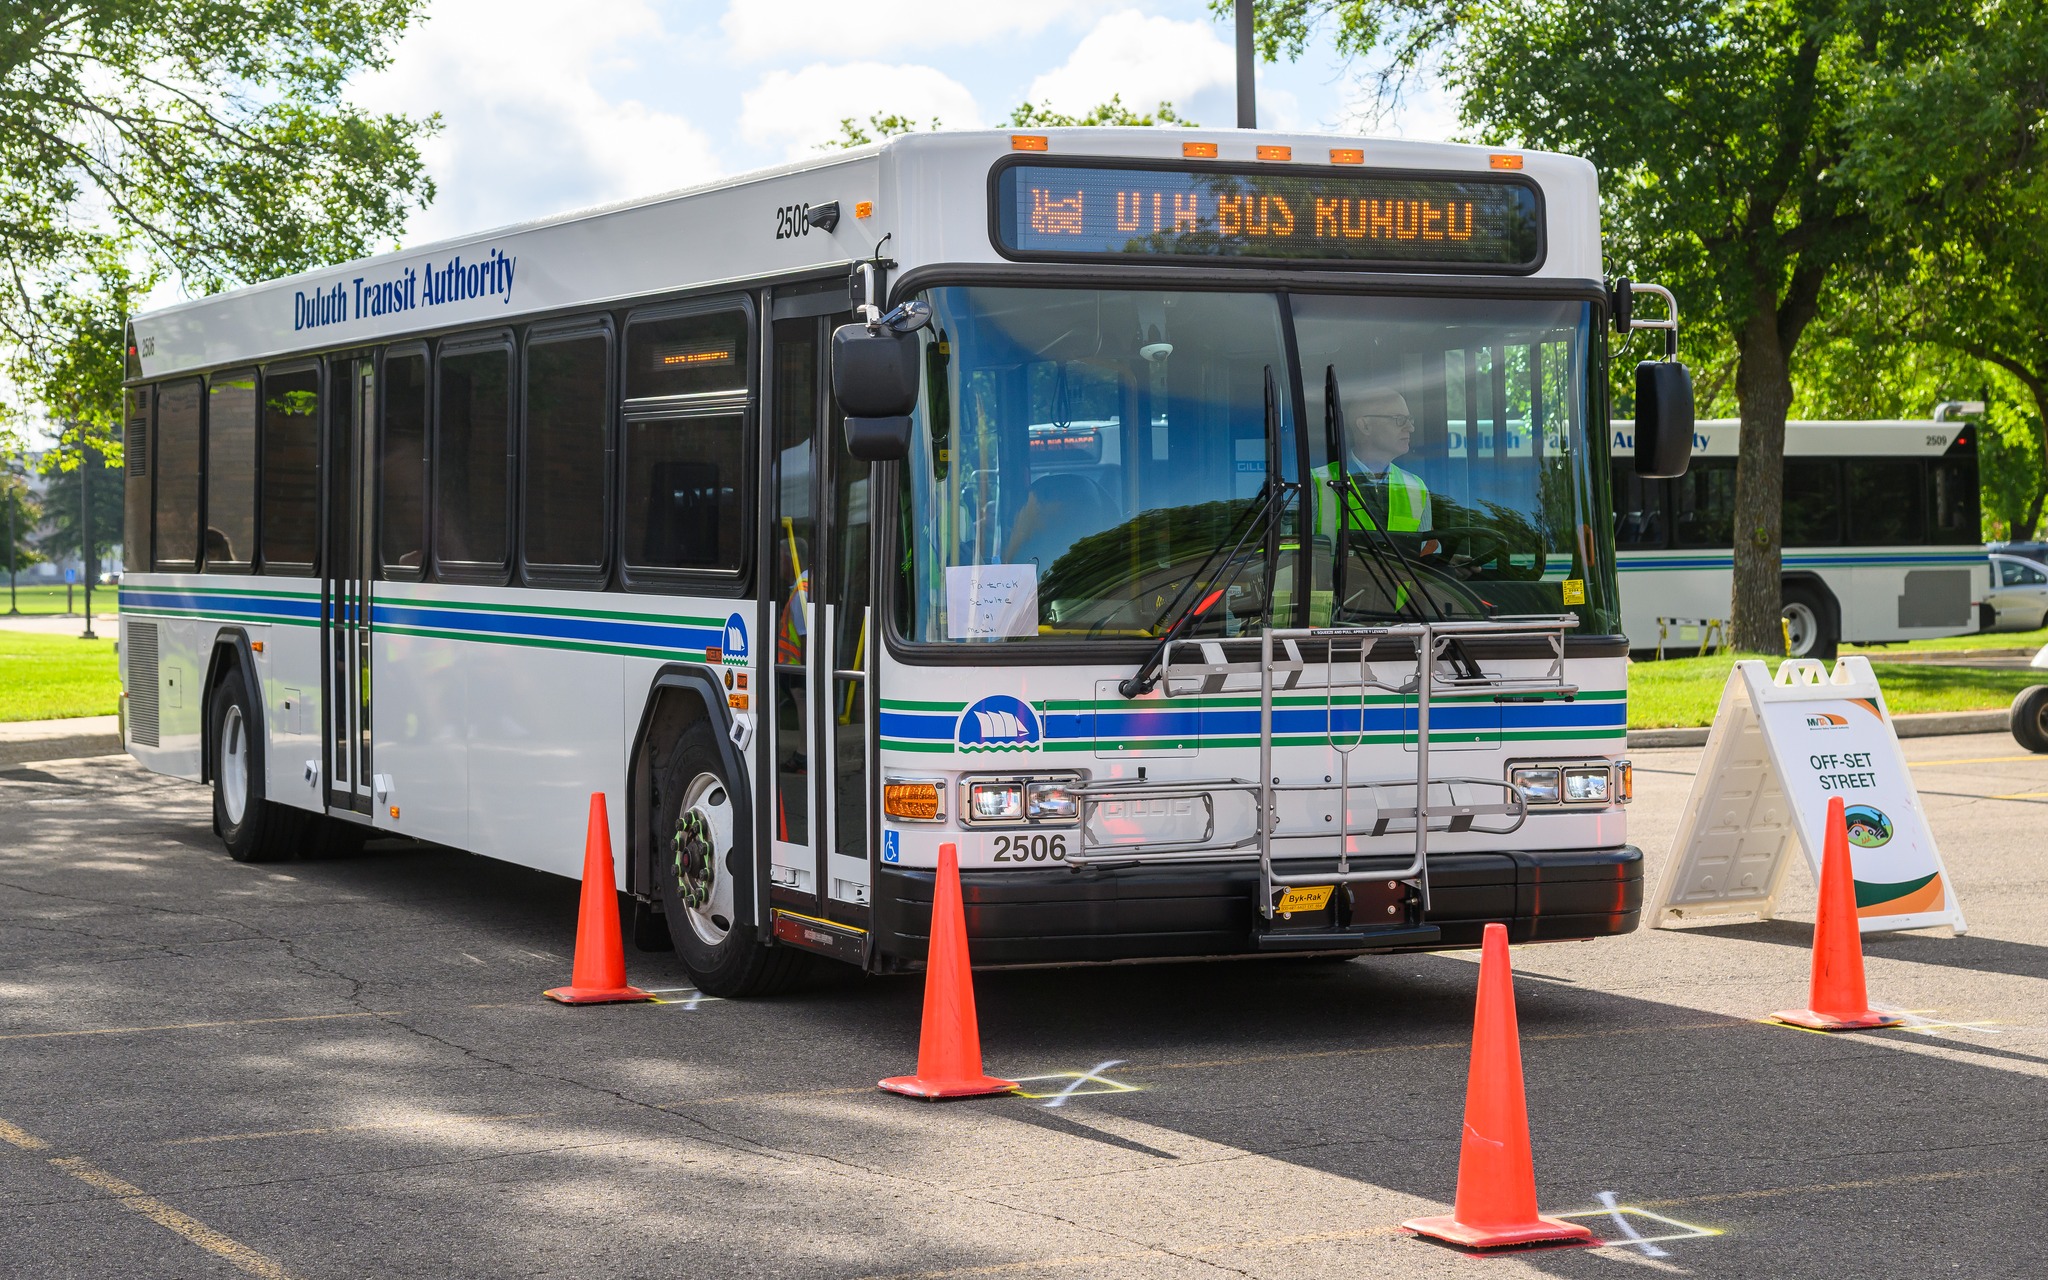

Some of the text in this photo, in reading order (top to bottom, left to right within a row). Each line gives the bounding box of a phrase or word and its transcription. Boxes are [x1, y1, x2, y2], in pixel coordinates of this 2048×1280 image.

[776, 202, 810, 240] 2506
[294, 248, 517, 331] Duluth Transit Authority
[1926, 435, 1947, 446] 2509
[970, 579, 1019, 589] Patrick
[1807, 717, 1829, 727] MVTA
[1810, 752, 1872, 770] OFF-SET
[1819, 772, 1876, 790] STREET
[993, 834, 1067, 862] 2506
[1289, 893, 1322, 904] Byk-Rak
